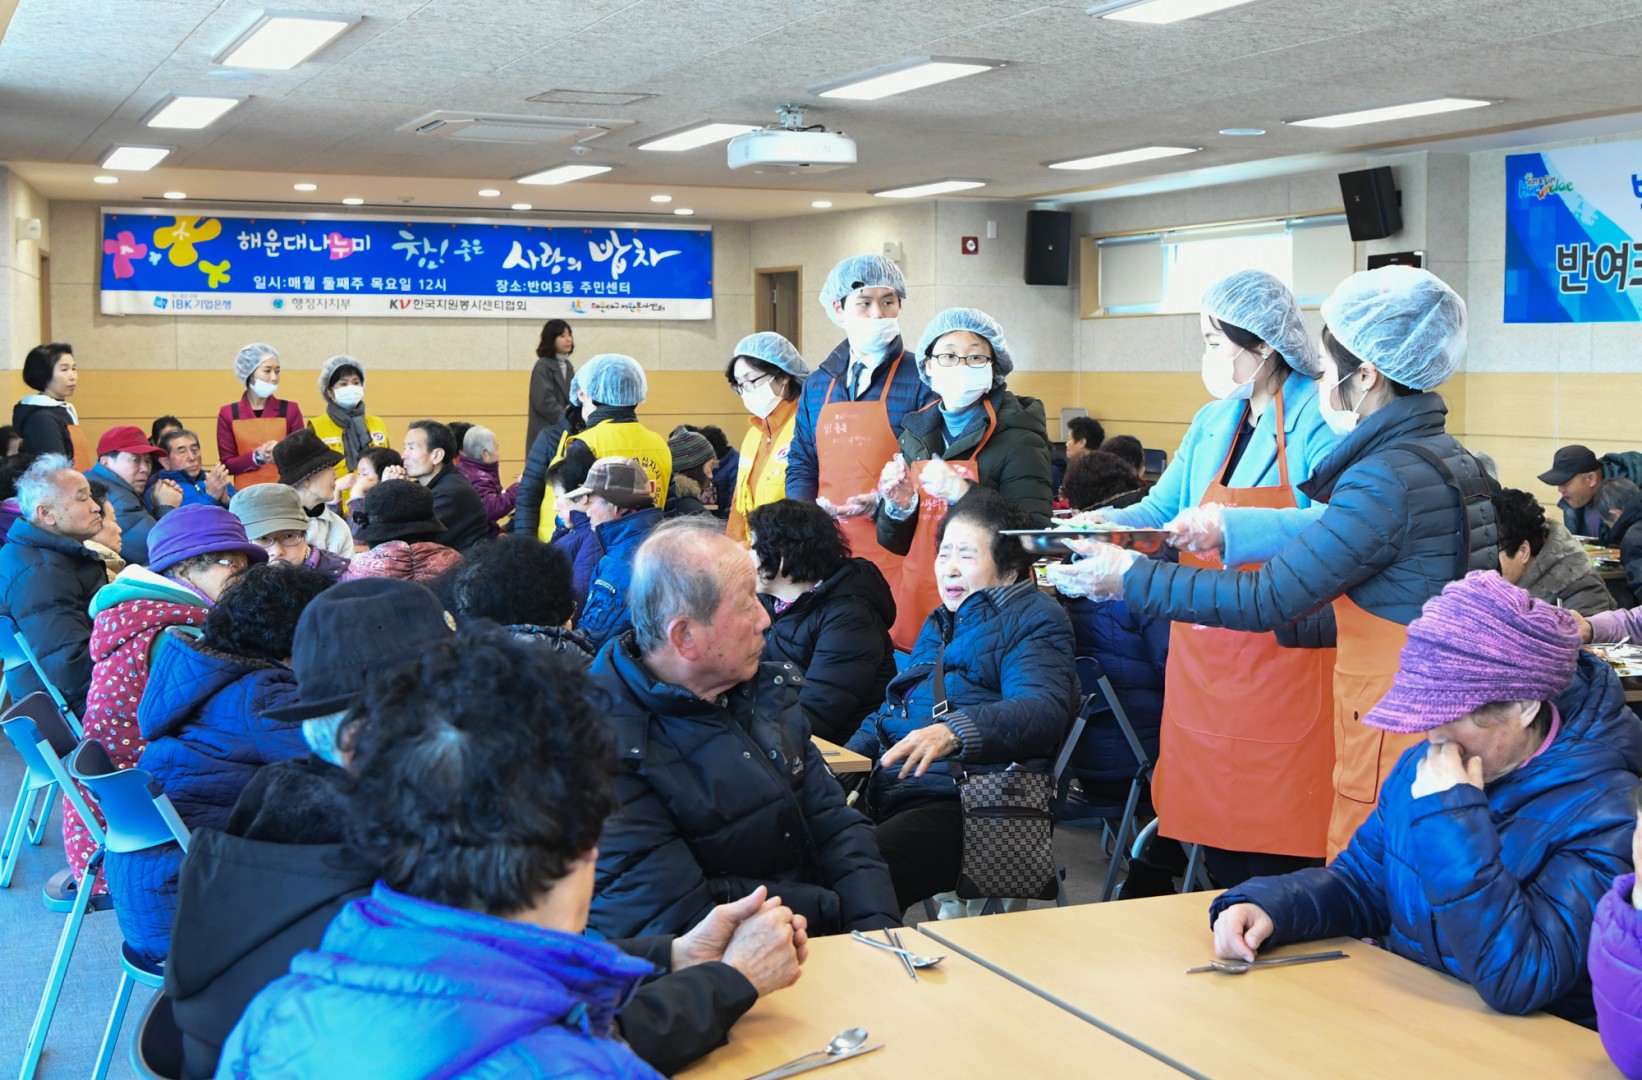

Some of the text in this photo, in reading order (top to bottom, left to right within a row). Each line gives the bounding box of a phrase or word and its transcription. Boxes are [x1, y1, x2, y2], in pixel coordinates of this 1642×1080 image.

[237, 229, 371, 258] 해운대나누미
[454, 239, 485, 262] 좋은
[502, 240, 582, 275] 사랑의
[589, 230, 682, 280] 밥차
[1556, 242, 1642, 293] 반여
[253, 276, 447, 291] 일시:매월 둘째주 목요일 12시
[496, 280, 631, 294] 장소:반여3동 주민센터
[171, 299, 232, 310] IBK 기업은행
[291, 297, 352, 310] 행정자치부
